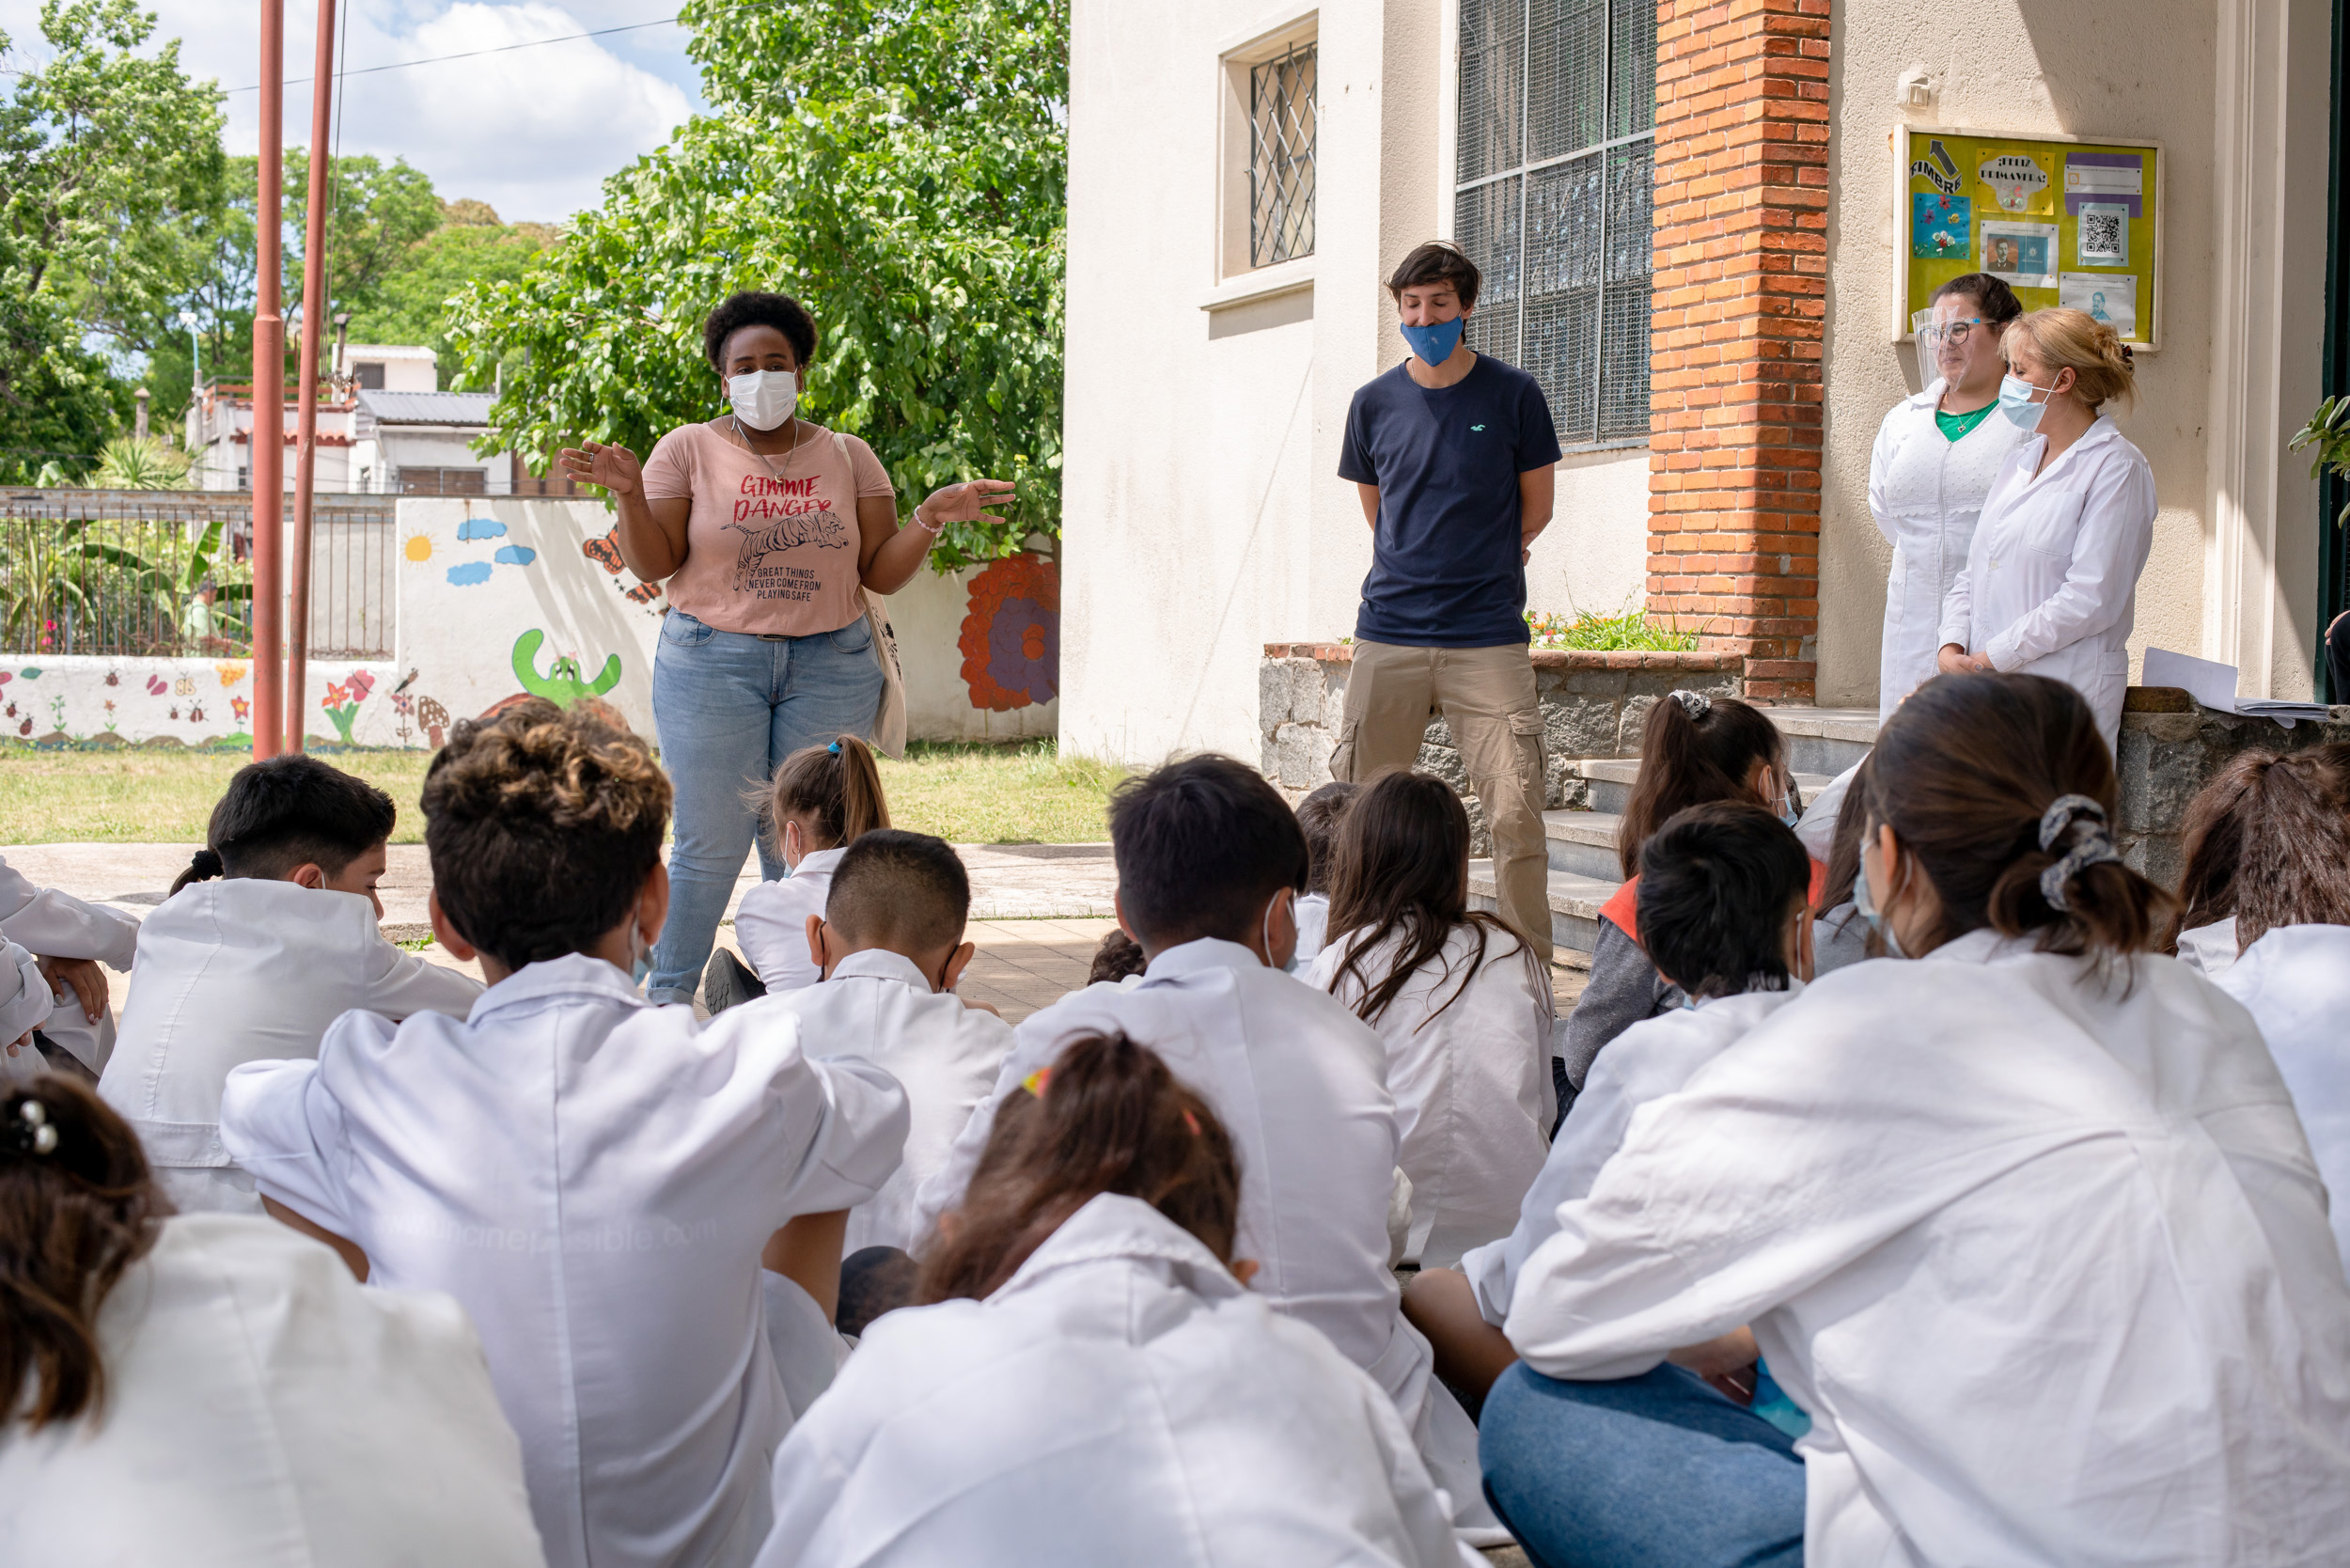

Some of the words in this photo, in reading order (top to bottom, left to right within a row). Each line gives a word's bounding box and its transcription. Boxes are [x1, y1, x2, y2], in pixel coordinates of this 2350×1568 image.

[1998, 158, 2030, 167] ¡FELIZ
[1910, 161, 1962, 194] TIMBRE
[1982, 170, 2045, 182] PRIMAVERA!
[741, 475, 821, 497] GIMME
[733, 498, 831, 524] DANGER
[758, 567, 784, 577] GREAT
[786, 567, 815, 579] THINGS
[748, 578, 776, 589] NEVER
[757, 590, 790, 600] PLAYING
[791, 591, 811, 602] SAFE
